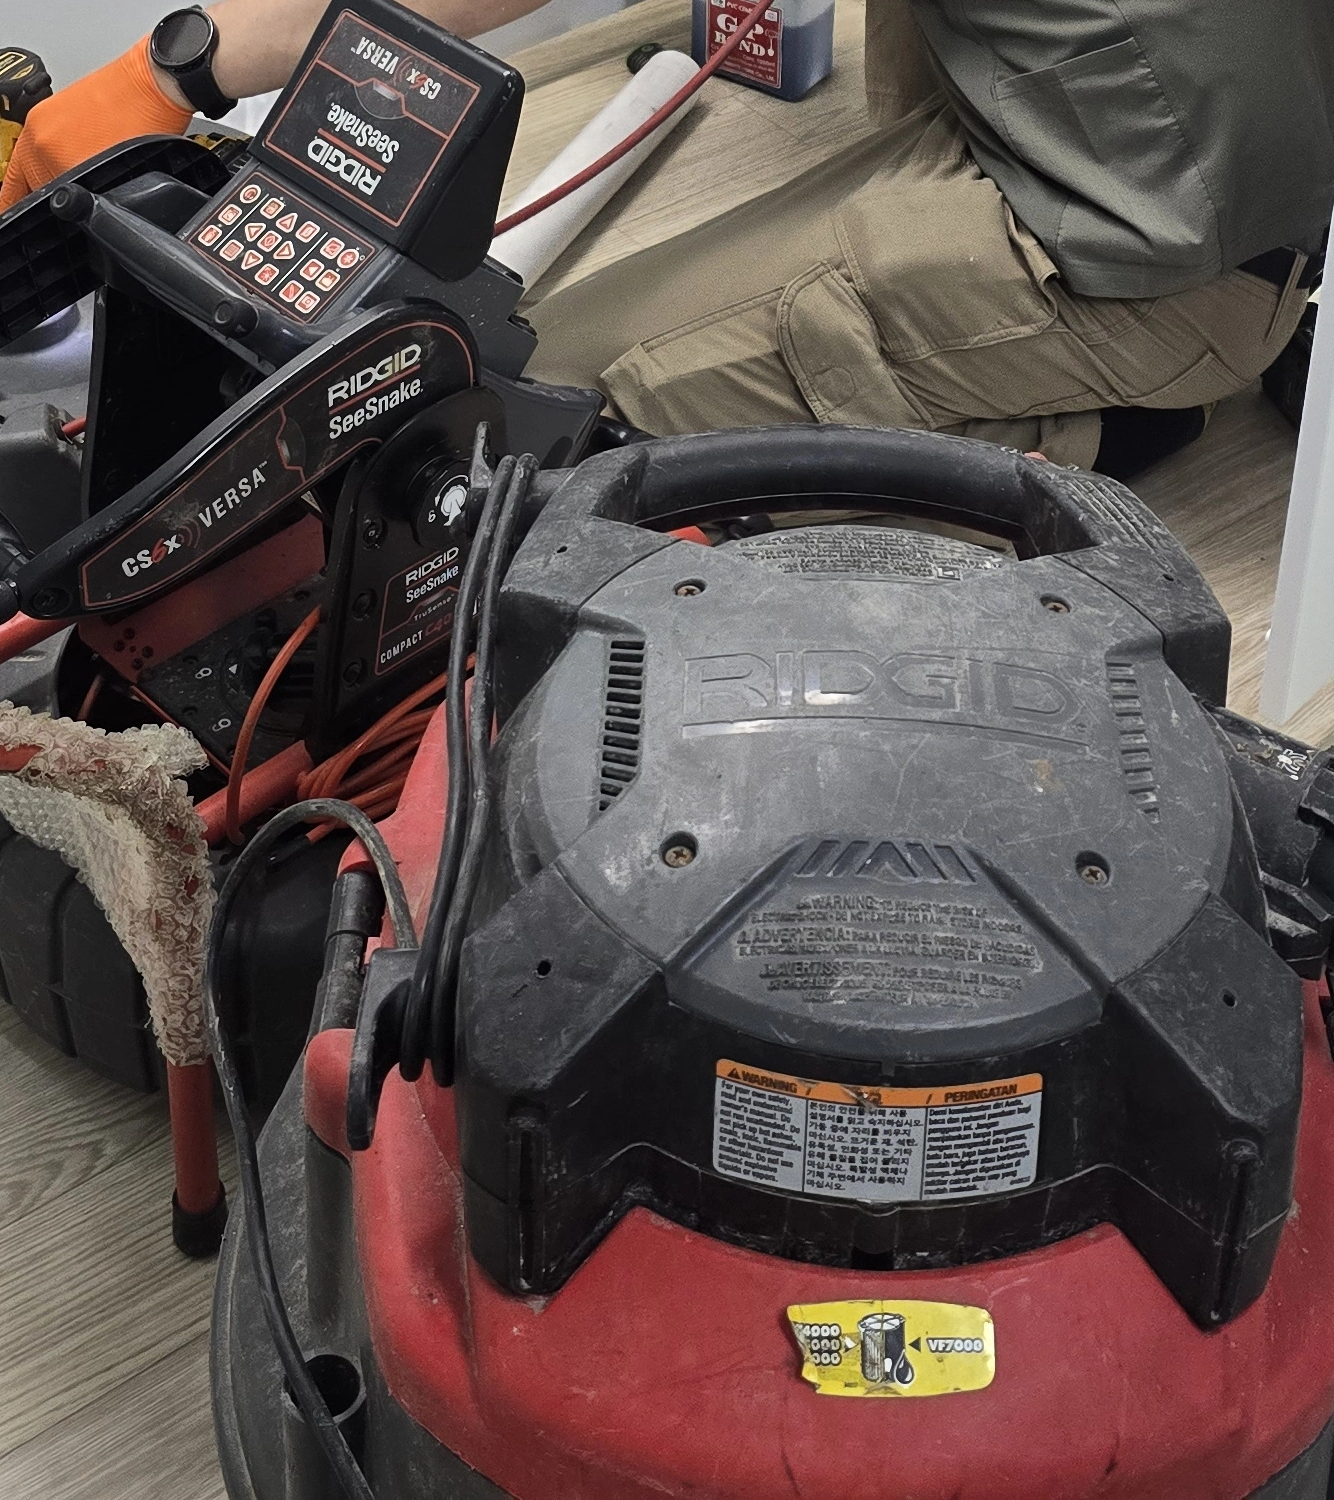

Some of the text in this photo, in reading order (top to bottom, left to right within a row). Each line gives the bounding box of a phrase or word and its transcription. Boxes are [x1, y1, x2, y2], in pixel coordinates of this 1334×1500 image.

[715, 30, 765, 57] BND
[307, 137, 383, 197] RIDGID
[326, 343, 422, 408] RIDGID
[328, 375, 423, 440] SeeSnake
[121, 534, 183, 579] CS6x
[405, 546, 460, 587] RIDGID
[405, 564, 460, 605] SeeSnake
[379, 630, 424, 665] COMPACT
[682, 647, 1082, 722] RIDGID
[741, 1070, 797, 1093] WARNING
[944, 1084, 1017, 1103] PERINGATAN
[926, 1338, 984, 1353] VF7000
